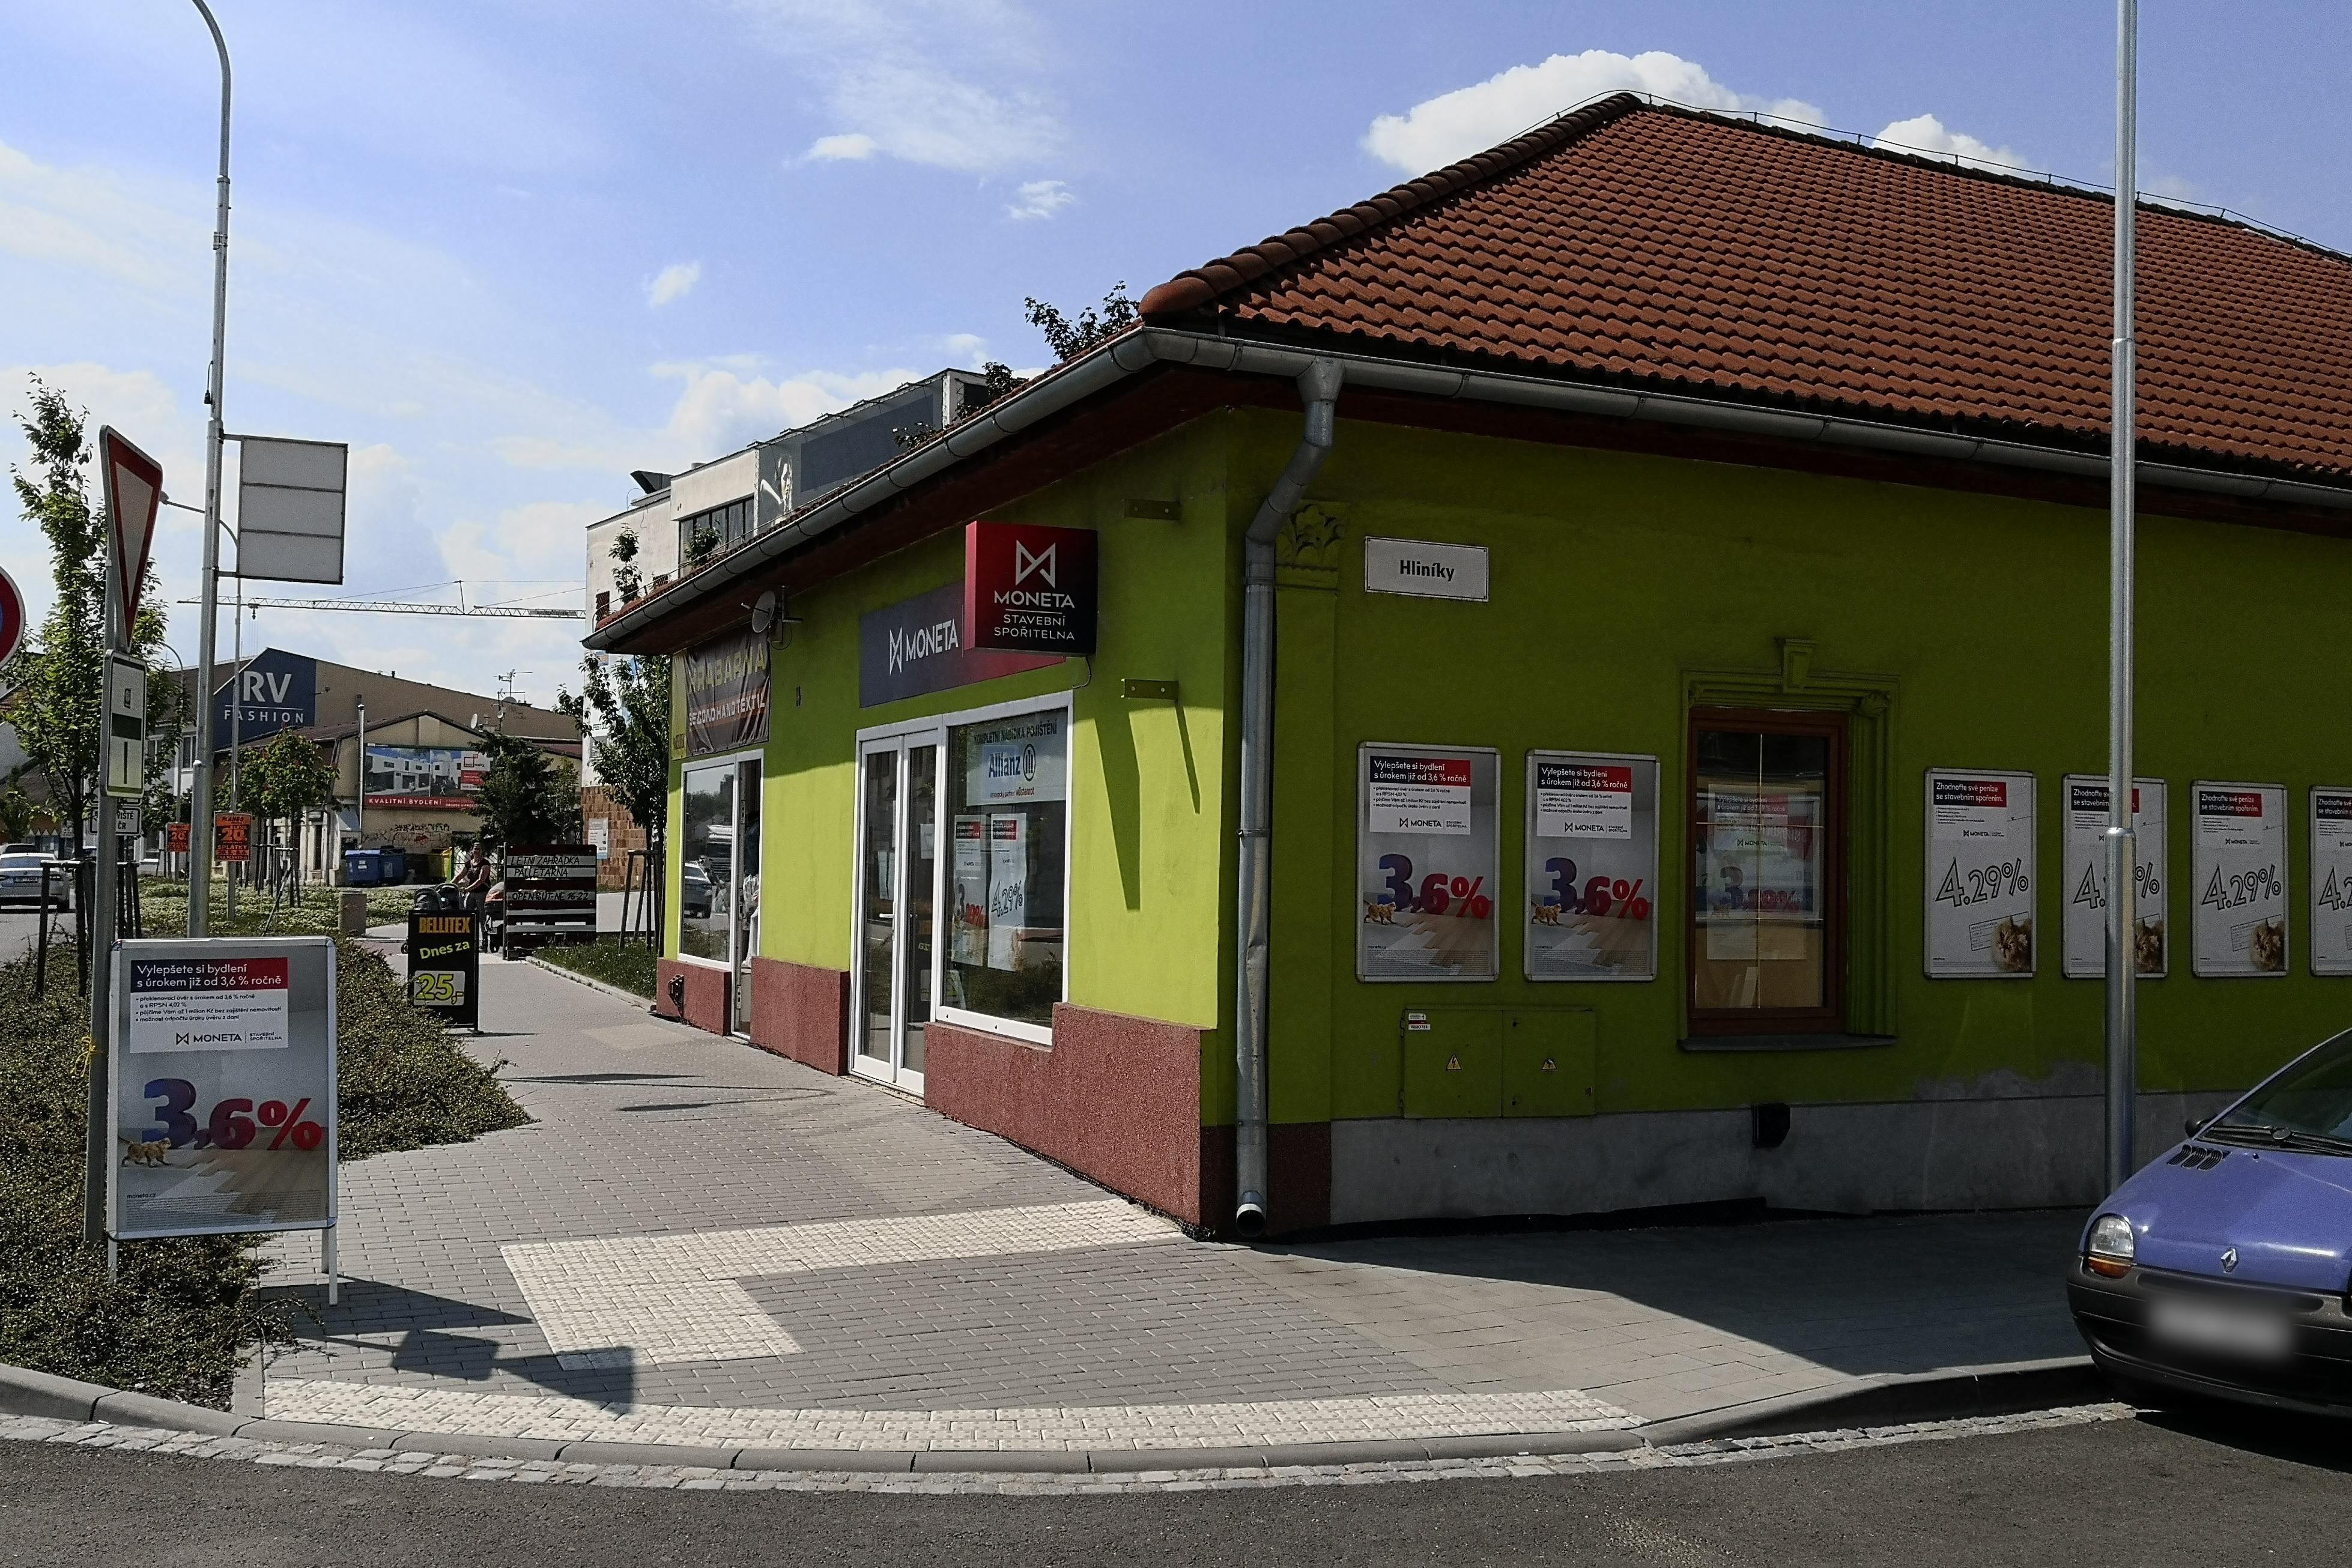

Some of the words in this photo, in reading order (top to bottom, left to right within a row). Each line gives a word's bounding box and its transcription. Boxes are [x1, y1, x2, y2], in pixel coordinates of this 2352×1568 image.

[1400, 560, 1455, 582] Hliníky
[994, 590, 1075, 609] MONETA
[1004, 614, 1066, 627] STAVEBNÍ
[906, 618, 959, 662] MONETA
[994, 626, 1075, 641] SPOŘITELNA
[243, 671, 292, 703] RV
[690, 707, 715, 726] SECOND
[717, 701, 736, 720] HAND
[736, 692, 765, 713] TEXTIL
[1026, 719, 1057, 738] POJIŠTĚNÍ
[989, 752, 1021, 778] Allianz
[1374, 760, 1411, 770] Vylepšete
[1419, 762, 1445, 772] bydlení
[1541, 767, 1575, 777] Vylepšete
[1583, 769, 1607, 779] bydlení
[1380, 772, 1407, 780] úrokem
[1417, 772, 1426, 781] od
[1428, 773, 1438, 782] 3,6
[1592, 780, 1601, 789] 3,6
[1936, 782, 1967, 791] Zhodnoťte
[1979, 784, 1998, 793] peníze
[2073, 789, 2103, 797] Zhodnoťte
[1975, 795, 2003, 803] spořením.
[2202, 794, 2228, 802] Zhodnoťte
[1377, 853, 1490, 919] 3,6%
[1544, 857, 1649, 920] 3,6%
[1935, 858, 2029, 907] 4.29%
[2201, 864, 2282, 910] 4.29%
[419, 916, 471, 933] BELLITEX
[419, 945, 453, 959] Dnes
[455, 941, 470, 951] za
[138, 964, 193, 977] Vylepšete
[196, 964, 205, 973] si
[207, 963, 247, 976] bydlení
[145, 977, 186, 987] úrokem
[189, 976, 201, 989] již
[204, 976, 218, 987] od
[220, 976, 236, 987] 3,6
[238, 975, 249, 985] %
[251, 975, 282, 985] ročně
[415, 973, 464, 1005] 25,-
[140, 1008, 162, 1017] půjčíme
[193, 1033, 243, 1043] MONETA
[142, 1078, 323, 1151] 3,6%
